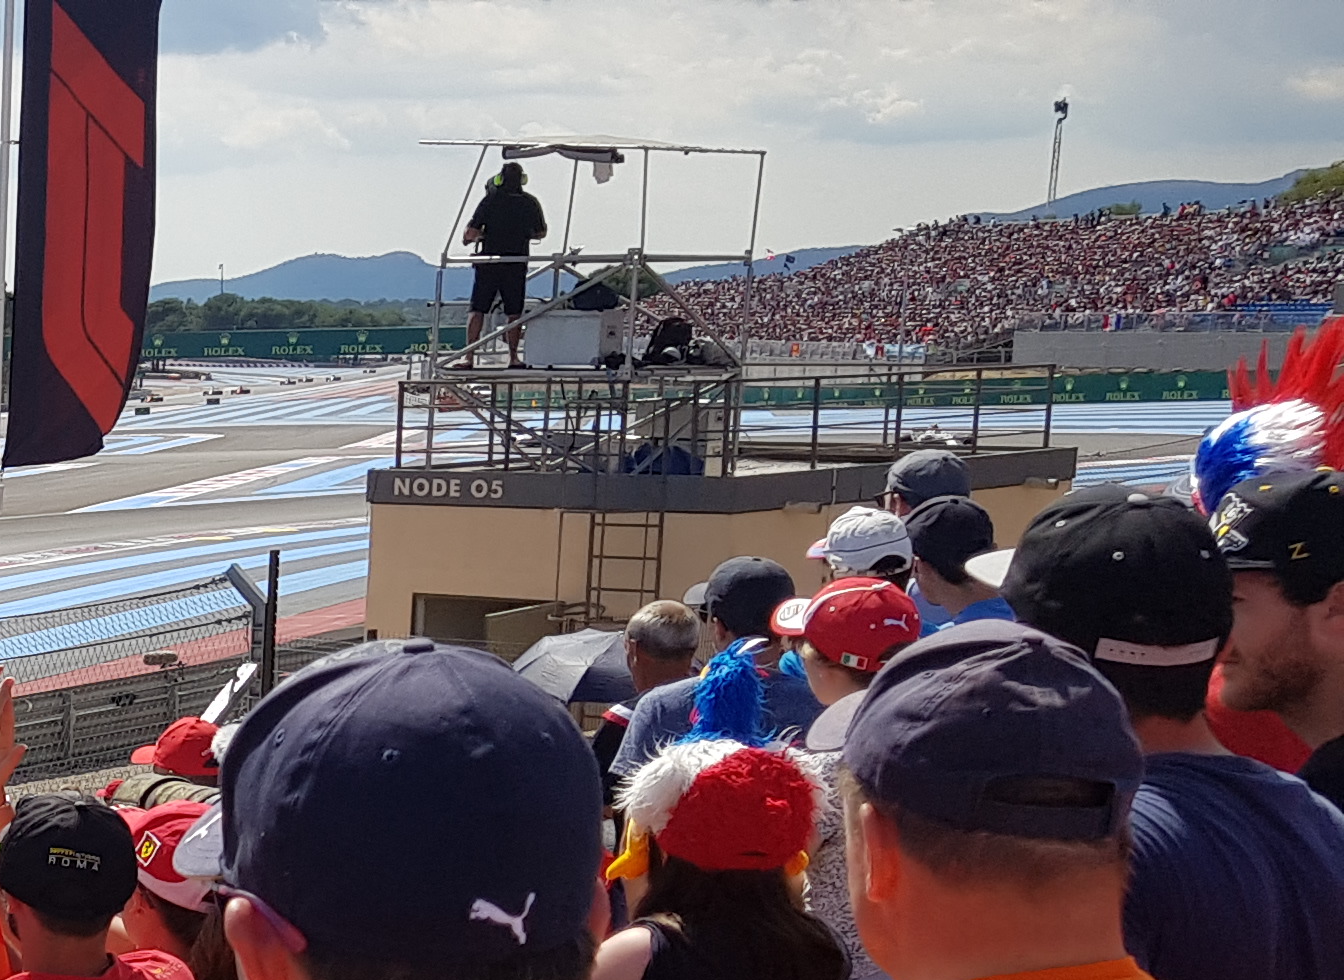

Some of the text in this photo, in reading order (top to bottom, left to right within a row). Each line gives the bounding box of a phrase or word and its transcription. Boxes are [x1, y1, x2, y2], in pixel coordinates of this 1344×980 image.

[204, 346, 245, 356] ROLEX
[272, 345, 313, 355] ROLEX
[340, 344, 383, 354] ROLEX
[1052, 393, 1085, 402] ROLEX
[1106, 392, 1141, 401] ROLEX
[1162, 391, 1198, 400] ROLEX
[394, 477, 461, 497] NODE
[48, 856, 99, 871] ROMA
